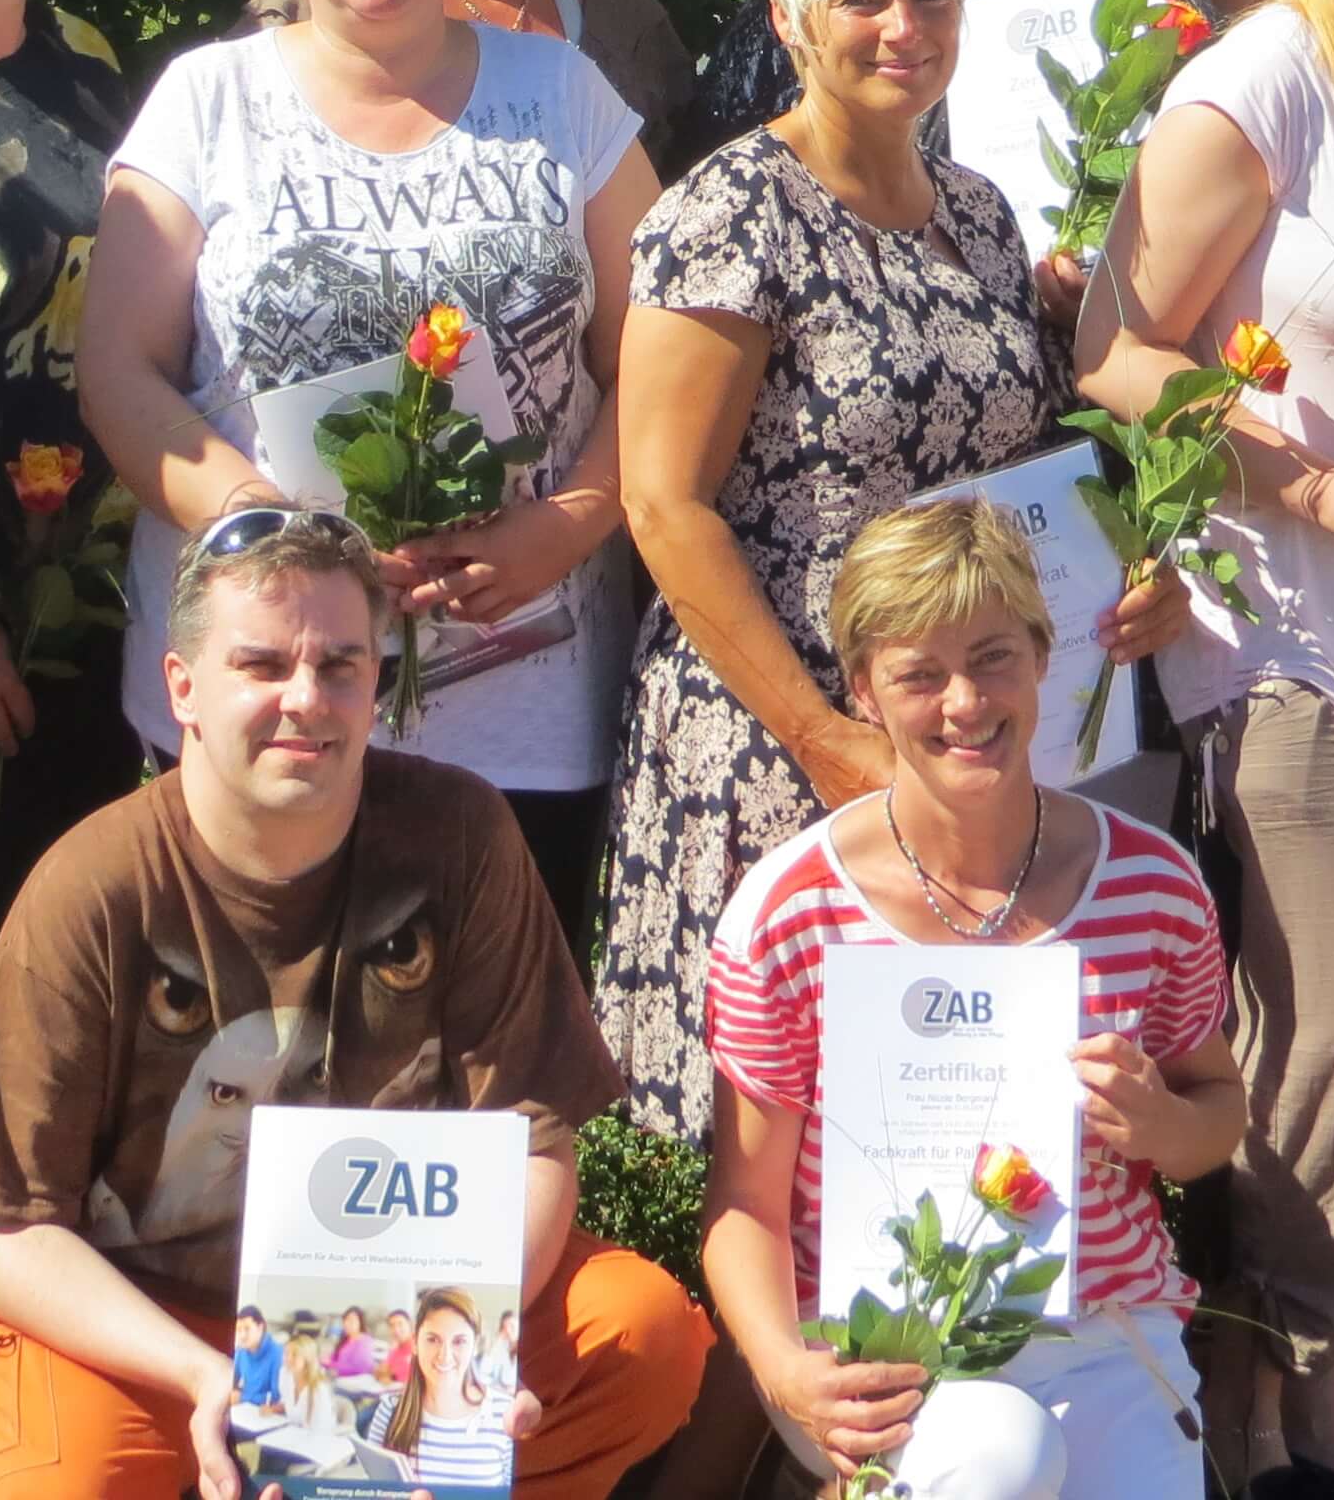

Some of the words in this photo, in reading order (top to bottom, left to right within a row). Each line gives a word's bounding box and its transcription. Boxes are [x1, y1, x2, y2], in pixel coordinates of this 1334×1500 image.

[1024, 9, 1077, 44] ZAB
[259, 157, 569, 234] ALWAYS
[1012, 503, 1047, 536] AB
[924, 991, 993, 1023] ZAB
[899, 1062, 1007, 1082] Zertifikat
[931, 1145, 949, 1159] für
[343, 1159, 459, 1217] ZAB
